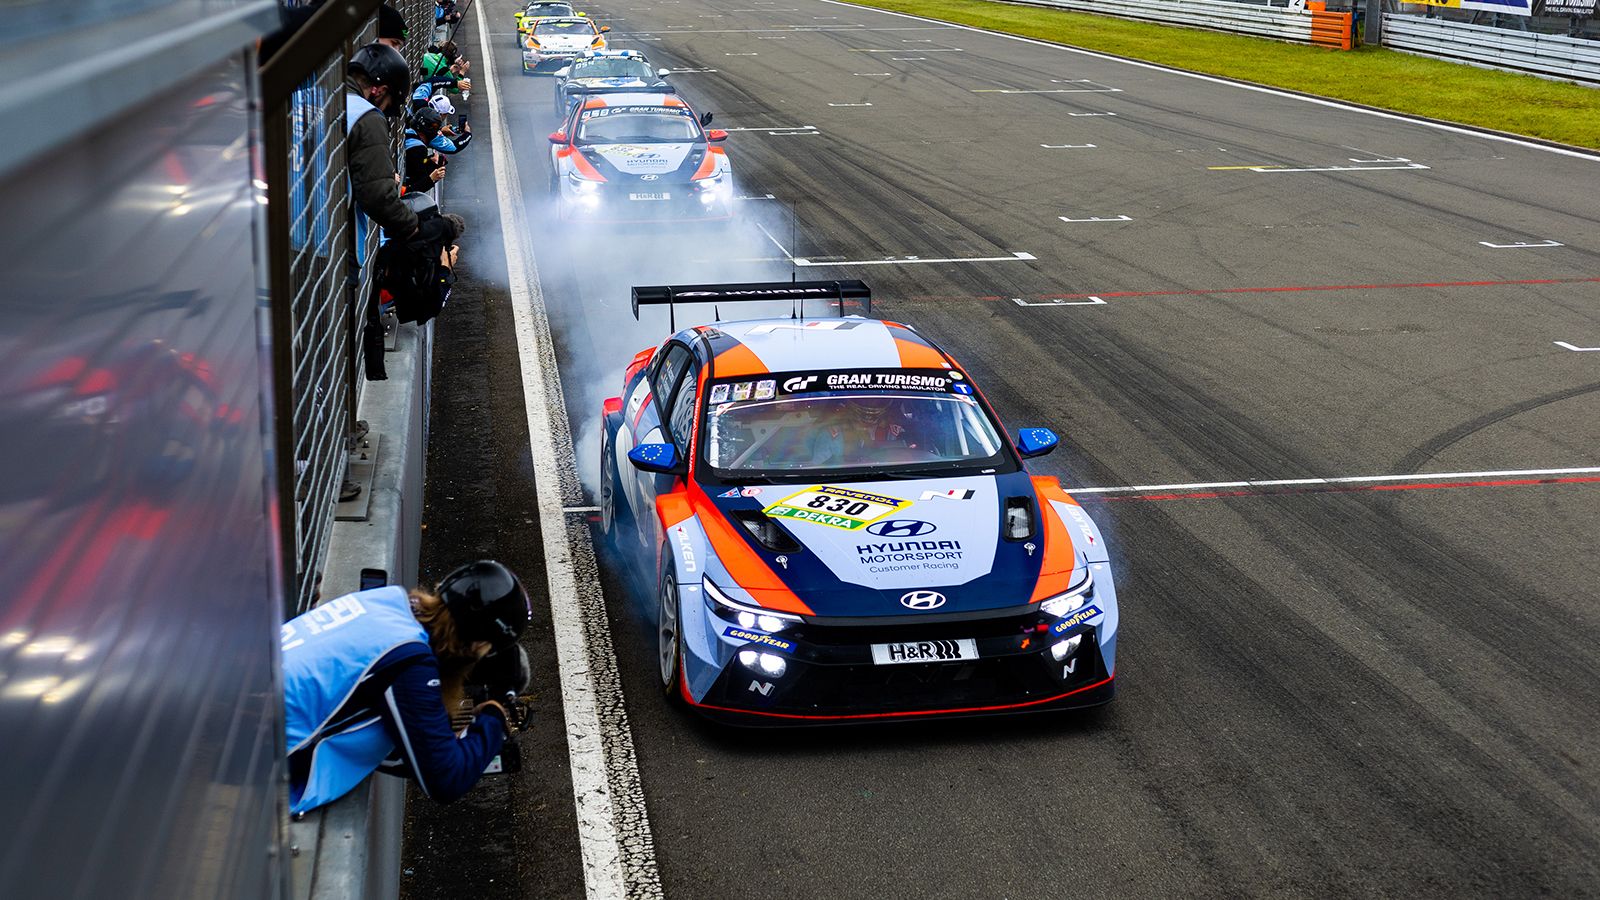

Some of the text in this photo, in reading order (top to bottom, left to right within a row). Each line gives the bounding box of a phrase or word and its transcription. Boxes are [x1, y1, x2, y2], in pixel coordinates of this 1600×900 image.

[826, 374, 946, 388] GRAN TURISMO
[901, 384, 946, 392] SIMULATOR
[823, 486, 896, 505] RAVENOL
[806, 494, 870, 517] 830
[793, 507, 852, 529] DEKRA
[856, 540, 962, 555] HYUNDAI
[860, 551, 963, 565] MOTORSPORT
[869, 561, 959, 573] Customer Racing
[1055, 608, 1097, 633] GOODYEAR
[729, 629, 790, 650] GOODYEAR
[888, 640, 934, 661] H&R
